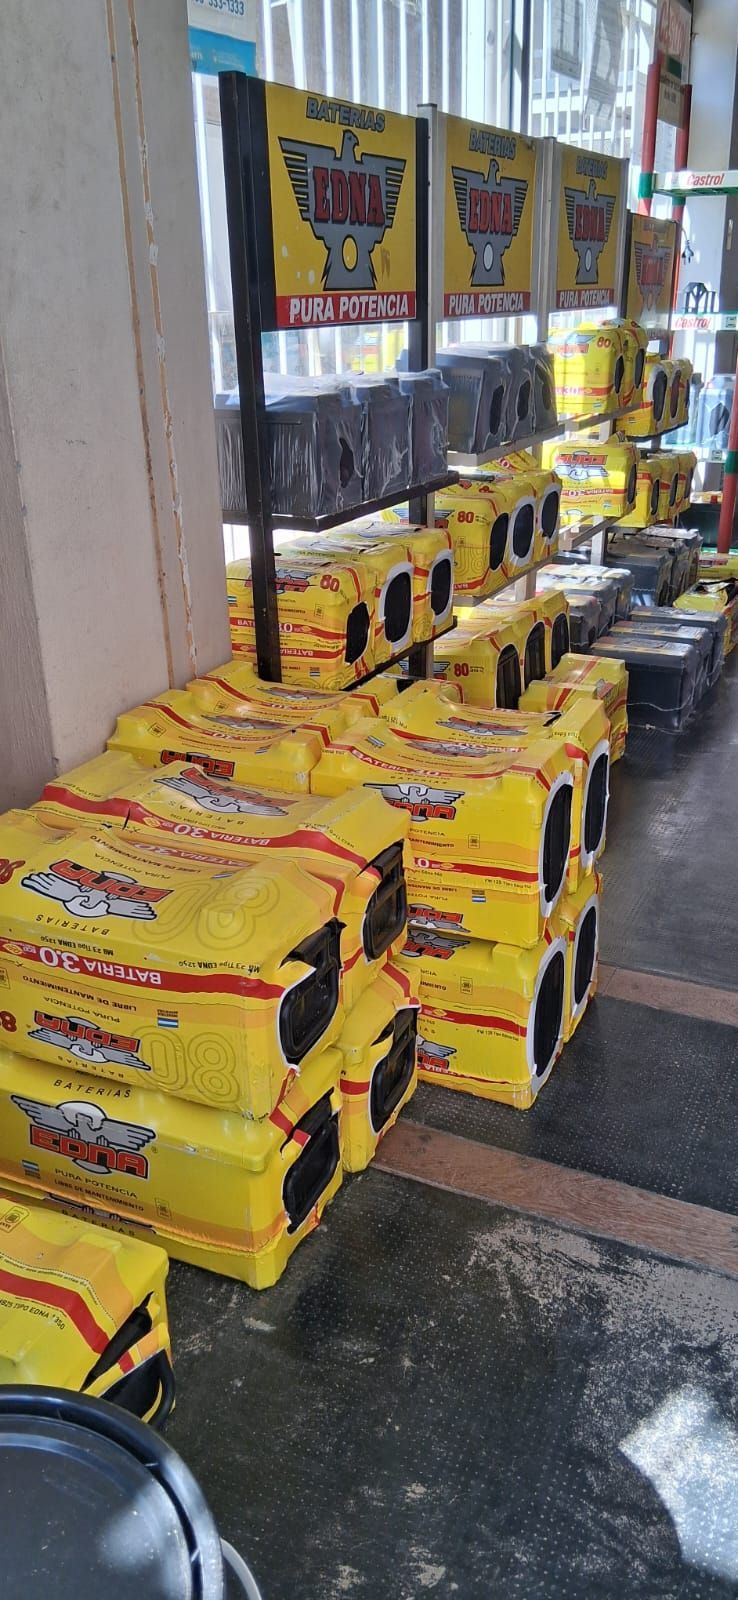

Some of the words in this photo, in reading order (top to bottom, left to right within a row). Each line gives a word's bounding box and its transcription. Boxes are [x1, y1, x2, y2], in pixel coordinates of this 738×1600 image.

[306, 96, 386, 133] BATERIAS
[468, 128, 517, 160] BATERIAS
[687, 173, 725, 187] Castrol
[312, 166, 386, 227] EDNA
[468, 188, 513, 235] EDNA
[575, 204, 607, 242] EDNA
[289, 296, 335, 323] PURA
[339, 293, 409, 320] POTENCIA
[449, 294, 475, 314] PURA
[478, 293, 523, 313] POTENCIA
[560, 291, 579, 308] PURA
[597, 336, 611, 348] 80
[457, 511, 474, 523] 80
[319, 574, 341, 593] 80
[454, 663, 470, 676] 80
[351, 749, 408, 772] BATERIA
[174, 824, 209, 840] 3.0
[211, 831, 271, 847] BATERIA
[89, 834, 162, 868] MANTENIMIENTO
[94, 852, 140, 874] POTENCIA
[49, 858, 174, 902] EDNA
[144, 870, 171, 880] PURA
[36, 914, 110, 936] BATERIAS
[58, 939, 76, 949] EDNA
[39, 946, 81, 973] 3.0
[197, 960, 217, 969] EDNA
[84, 960, 161, 985] BATERIA
[22, 974, 94, 1002] MANTENIMIENTO
[42, 996, 92, 1016] POTENCIA
[96, 997, 109, 1006] DE
[111, 1001, 137, 1012] LIBRE
[93, 1010, 121, 1023] PURA
[34, 1010, 141, 1053] EDNA
[57, 1055, 124, 1079] BATERIAS
[53, 1079, 132, 1098] BATERIAS
[29, 1123, 149, 1180] EDNA
[54, 1178, 73, 1190] LIBRE
[74, 1184, 84, 1193] DE
[85, 1188, 145, 1212] MANTENIMIENTO
[55, 1168, 82, 1182] PURA
[85, 1177, 138, 1200] POTENCIA
[29, 1305, 49, 1319] EDNA
